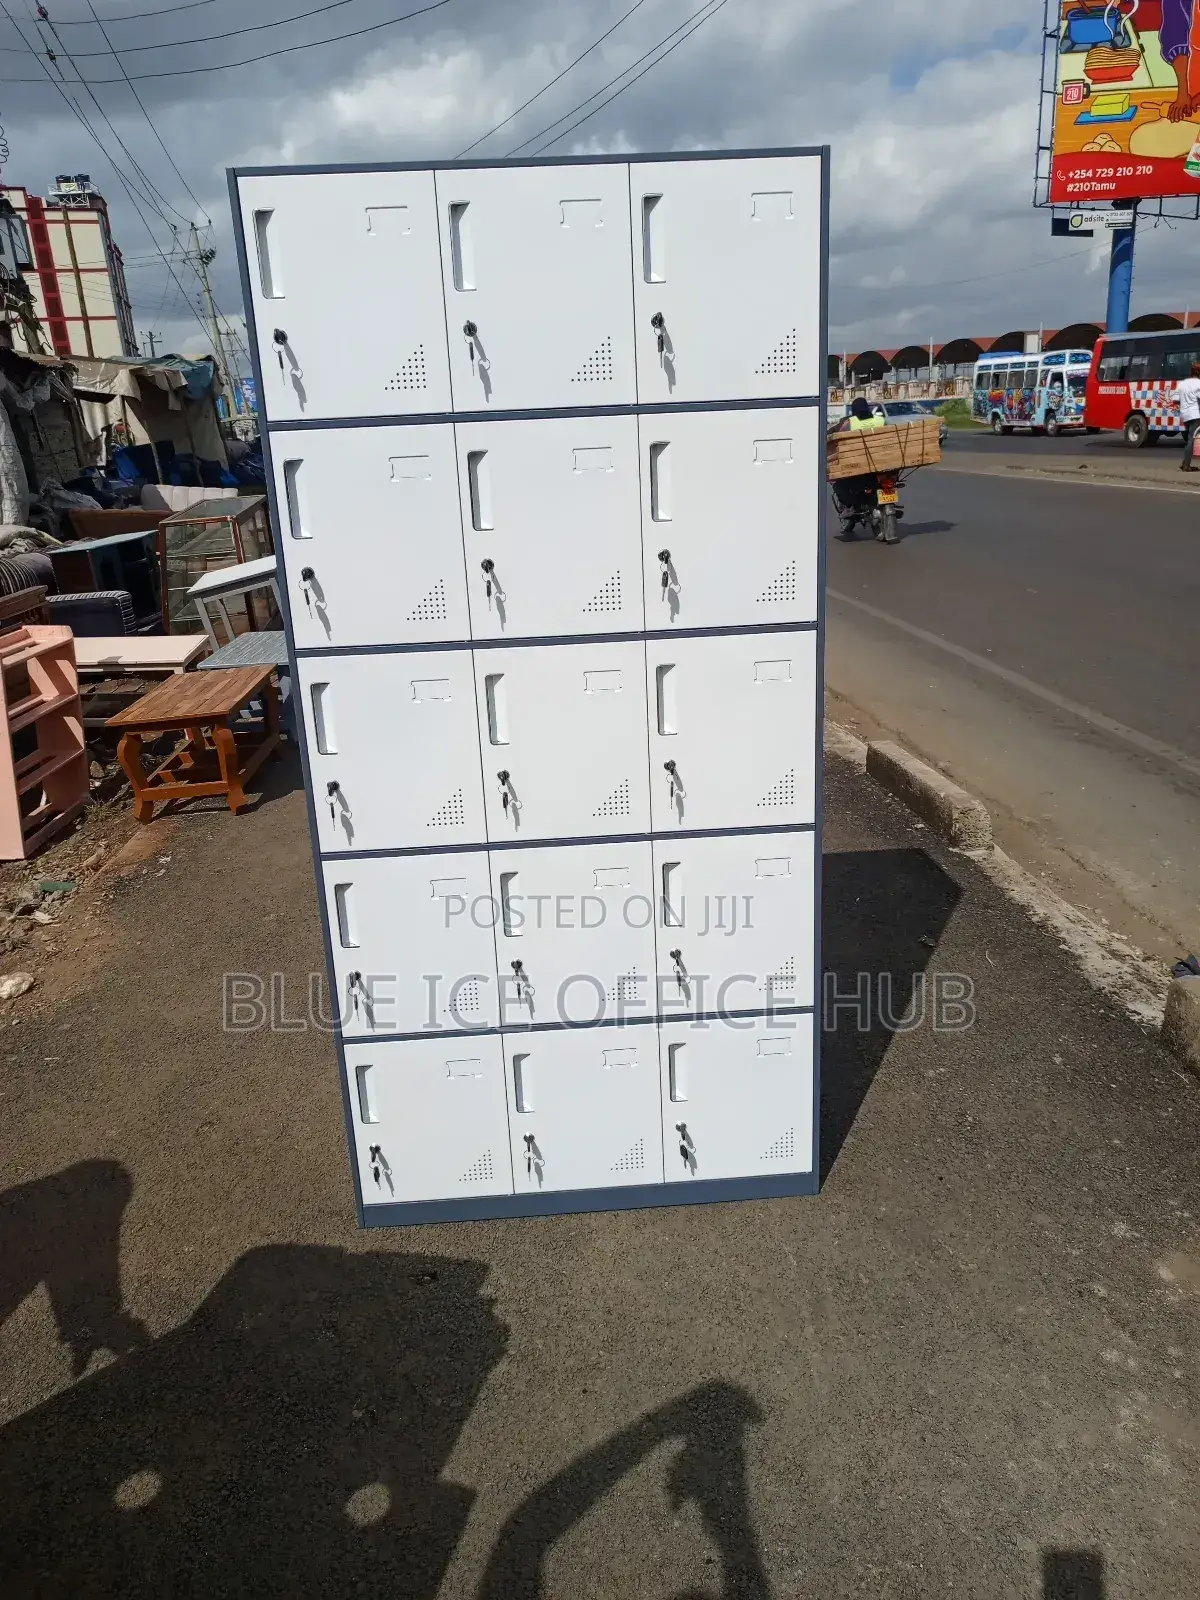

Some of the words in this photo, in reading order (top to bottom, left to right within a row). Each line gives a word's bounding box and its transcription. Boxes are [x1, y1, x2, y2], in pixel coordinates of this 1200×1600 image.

[1066, 87, 1079, 100] 210
[1068, 169, 1093, 179] +254
[1095, 167, 1114, 178] 729
[1116, 166, 1134, 177] 210
[1136, 165, 1153, 175] 210
[1066, 181, 1116, 192] #210Tamu
[1084, 214, 1105, 223] adsite
